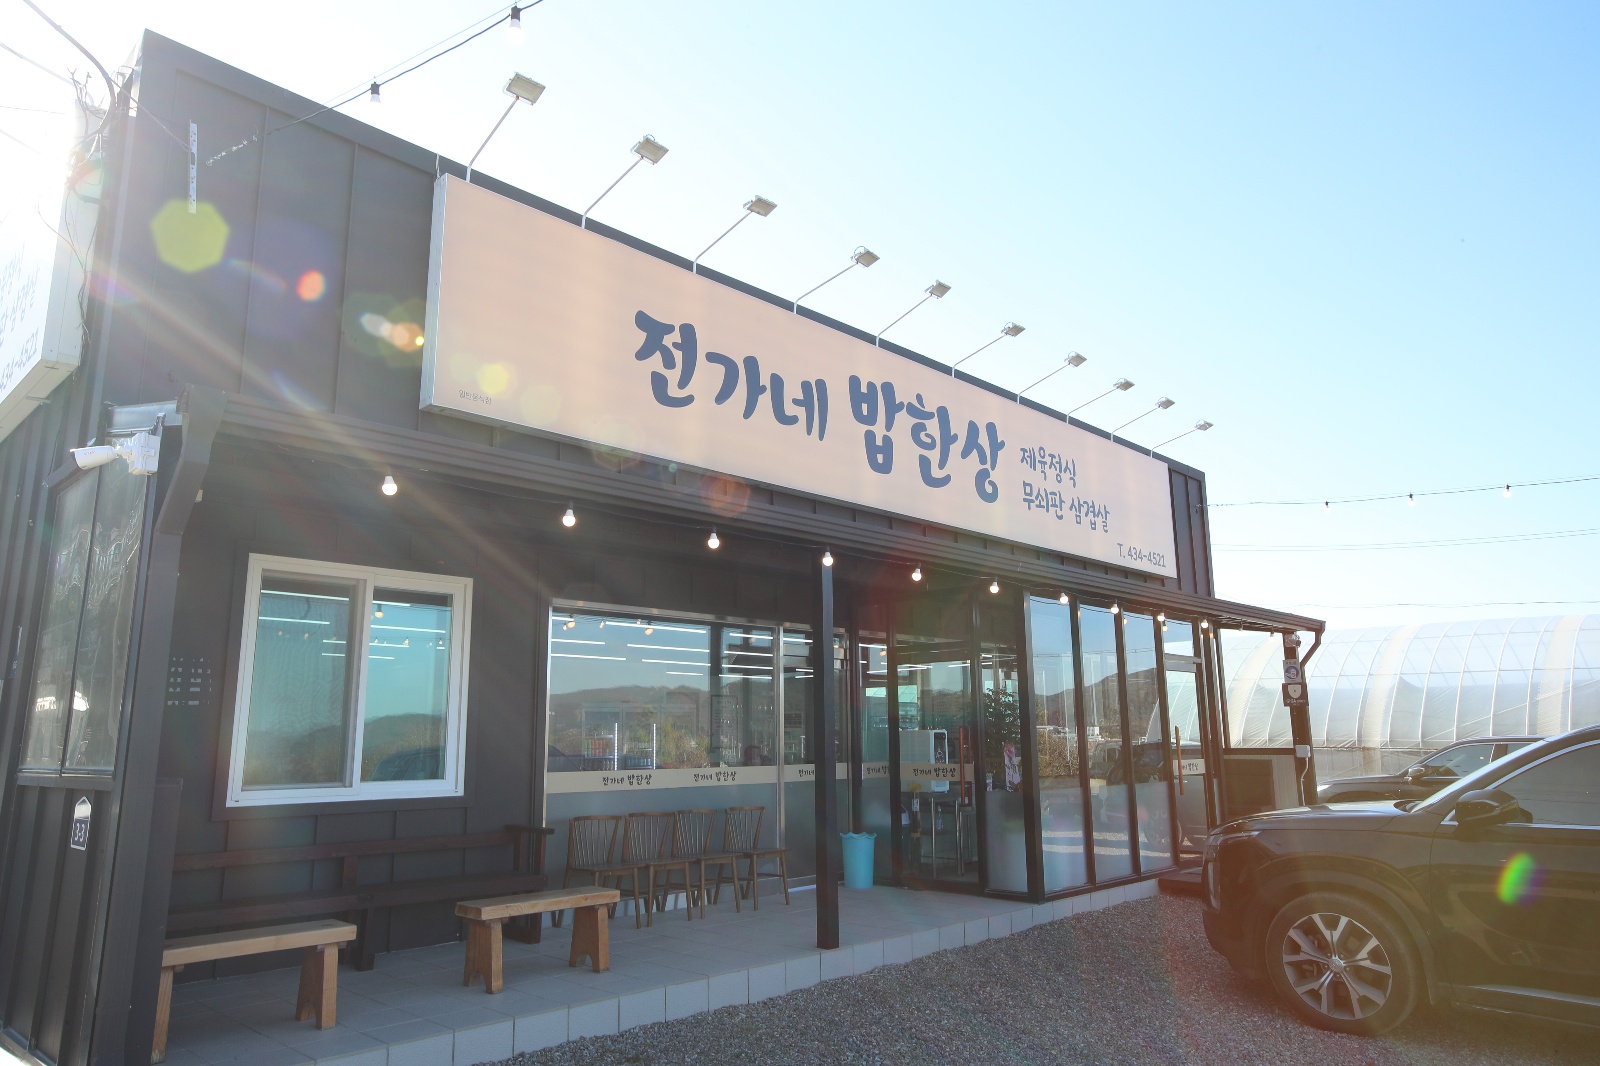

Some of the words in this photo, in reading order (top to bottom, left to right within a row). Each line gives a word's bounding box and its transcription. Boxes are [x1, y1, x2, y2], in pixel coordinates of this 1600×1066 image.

[458, 389, 492, 405] 일반음식점
[634, 310, 829, 441] 전가네
[848, 374, 1006, 504] 밥한상
[1019, 446, 1077, 489] 제육정식
[1022, 480, 1065, 520] 무쇠판
[1069, 496, 1110, 533] 삼겹살
[1127, 545, 1167, 568] 434-4521
[602, 776, 625, 786] 전가네
[627, 774, 653, 786] 밥한상
[693, 773, 713, 783] 전가네
[715, 770, 737, 782] 밥한상
[933, 766, 957, 778] 밥한상
[75, 822, 86, 842] 3-3
